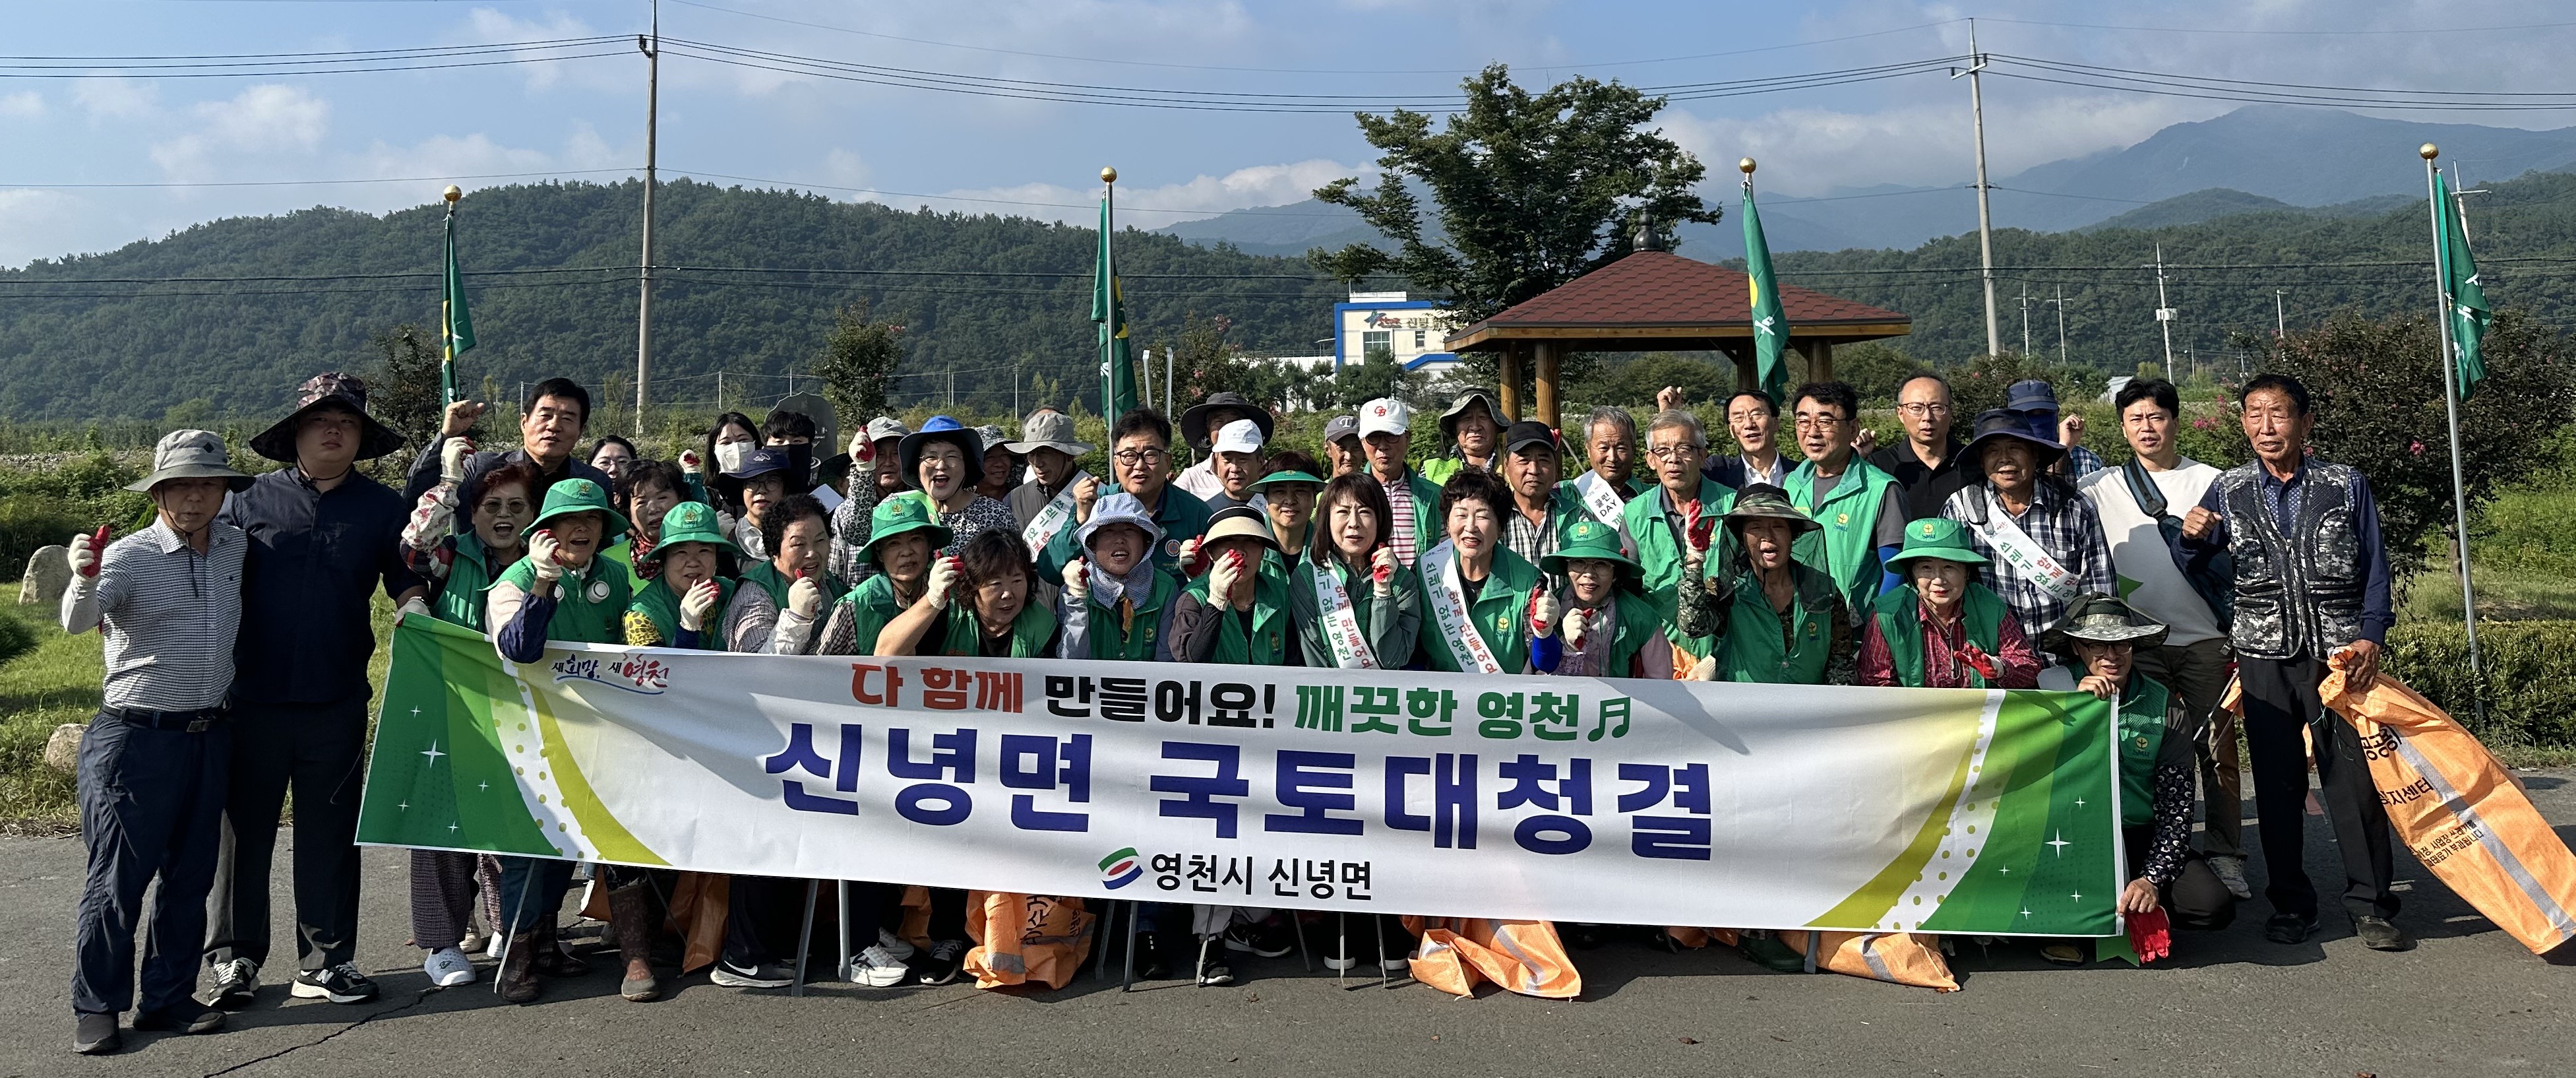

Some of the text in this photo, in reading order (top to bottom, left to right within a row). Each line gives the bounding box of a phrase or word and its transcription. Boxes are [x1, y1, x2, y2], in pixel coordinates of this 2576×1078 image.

[1026, 499, 1064, 541] 쓰레기 없
[1599, 499, 1617, 517] DAY
[1612, 512, 1623, 525] 깨
[2000, 542, 2033, 570] 쓰레기
[2035, 571, 2063, 593] 없는
[2037, 555, 2064, 579] 함께
[1316, 566, 1352, 660] 레기 없는 영천
[1335, 585, 1351, 611] 함께
[1426, 562, 1444, 598] 쓰레기
[1438, 606, 1456, 636] 없는
[1452, 637, 1476, 667] 영천
[1448, 590, 1464, 618] 함께
[852, 662, 1579, 742] 다 함께 만들어요! 깨끗한 영천
[766, 723, 1711, 861] 신녕면 국토대청결
[2430, 835, 2452, 850] 사업장
[2451, 829, 2485, 852] 부과됩니다
[1151, 854, 1372, 901] 영천시 신녕면
